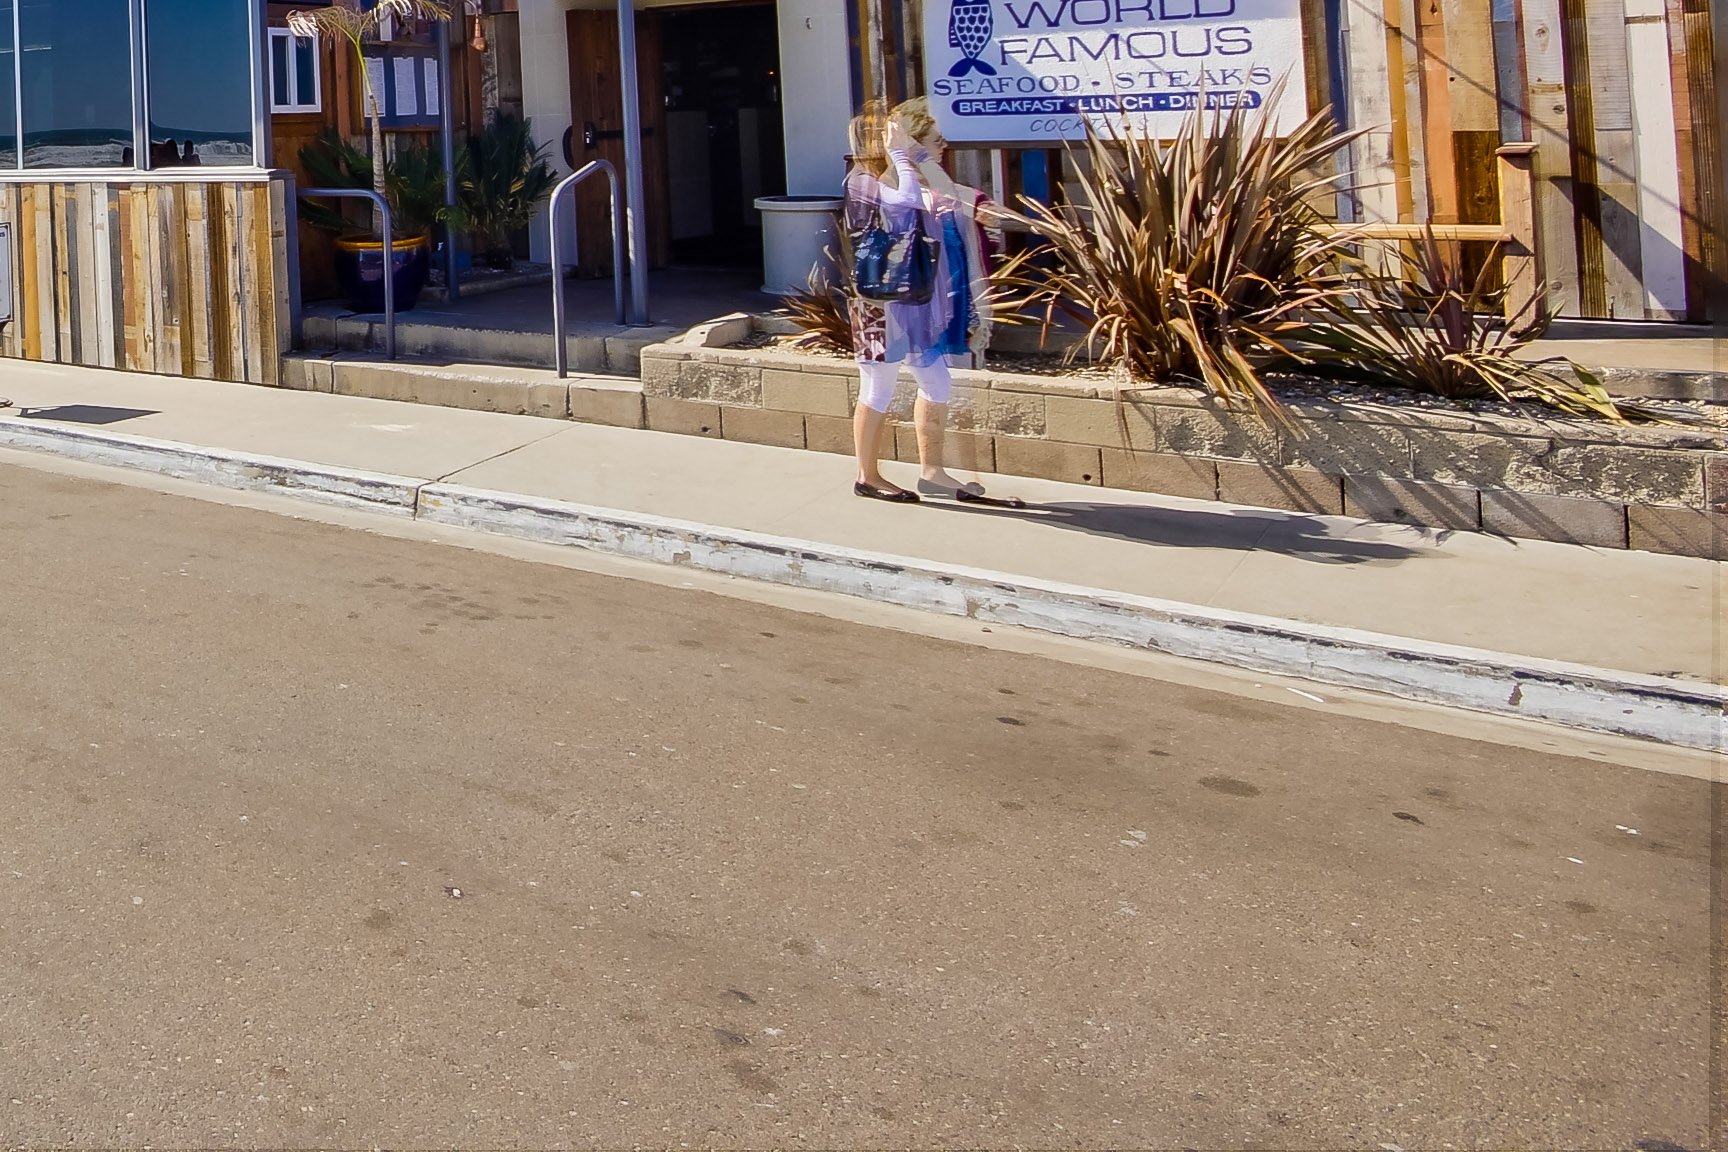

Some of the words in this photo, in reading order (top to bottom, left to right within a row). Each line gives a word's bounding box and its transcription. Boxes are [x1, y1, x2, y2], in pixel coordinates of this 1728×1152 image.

[998, 26, 1253, 66] FAMOUS
[933, 74, 1080, 97] SEAFOOD
[1115, 67, 1272, 89] STEAKS
[959, 99, 1064, 113] BREAKFAST
[1078, 95, 1153, 111] LUNCH
[1168, 93, 1255, 110] DINNER
[1030, 117, 1150, 133] COCKTAIS
